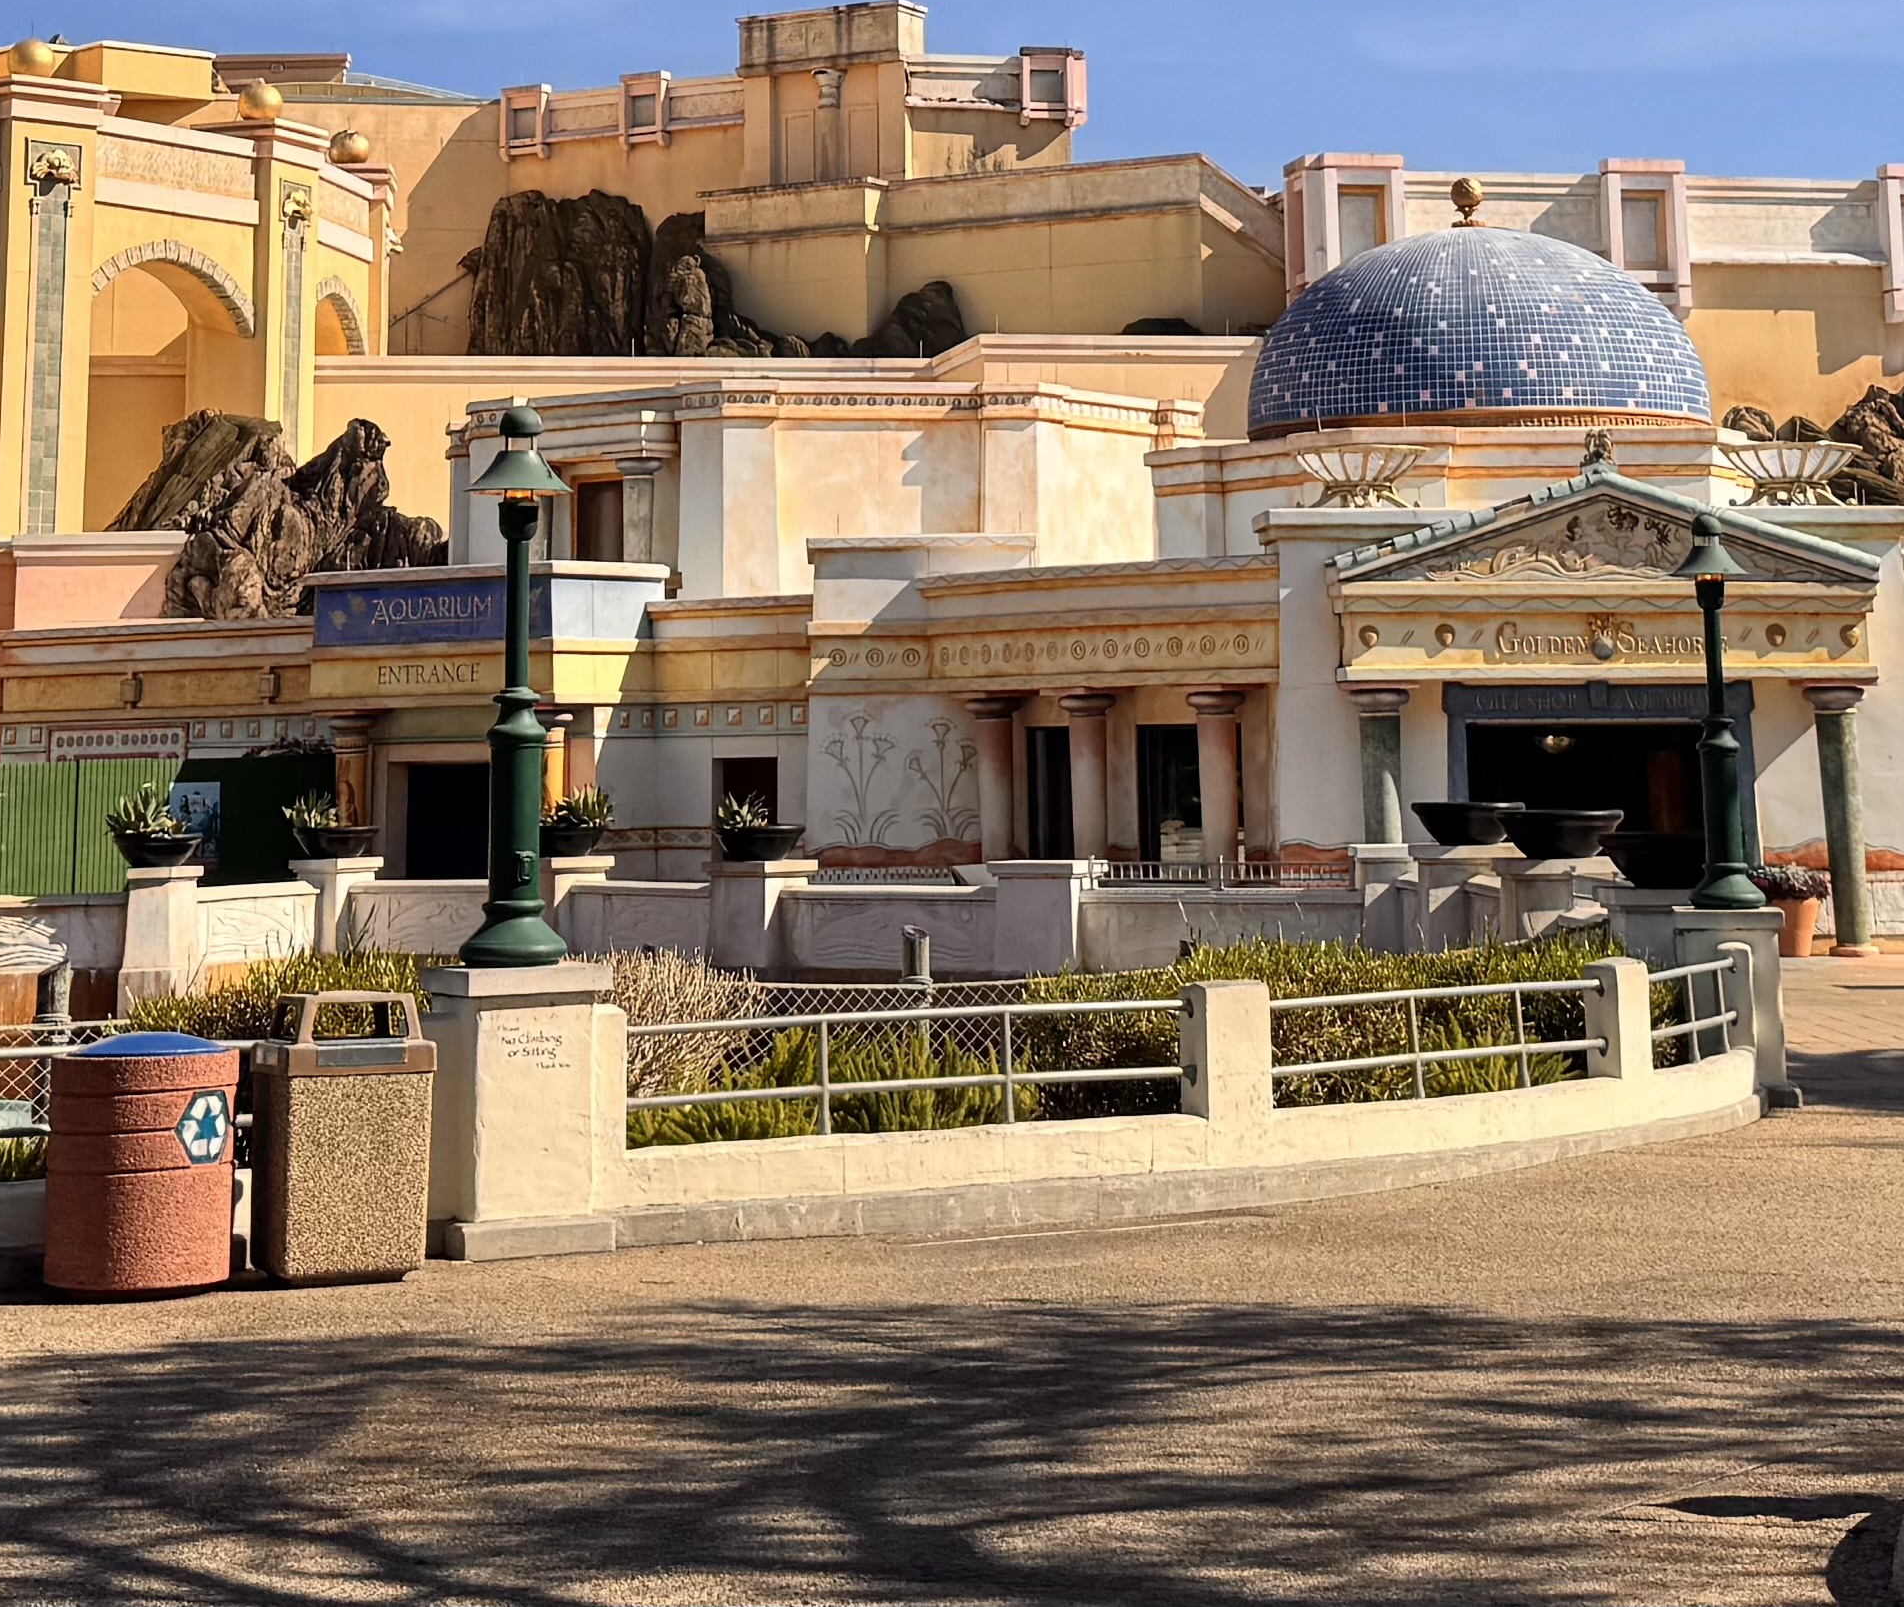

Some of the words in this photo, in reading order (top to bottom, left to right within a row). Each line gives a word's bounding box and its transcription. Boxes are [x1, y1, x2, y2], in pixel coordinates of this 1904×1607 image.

[371, 595, 492, 626] AQUARIUM
[1495, 621, 1589, 655] GOLDEN
[1616, 621, 1729, 655] SEAHORE
[377, 662, 481, 685] ENTRANCE
